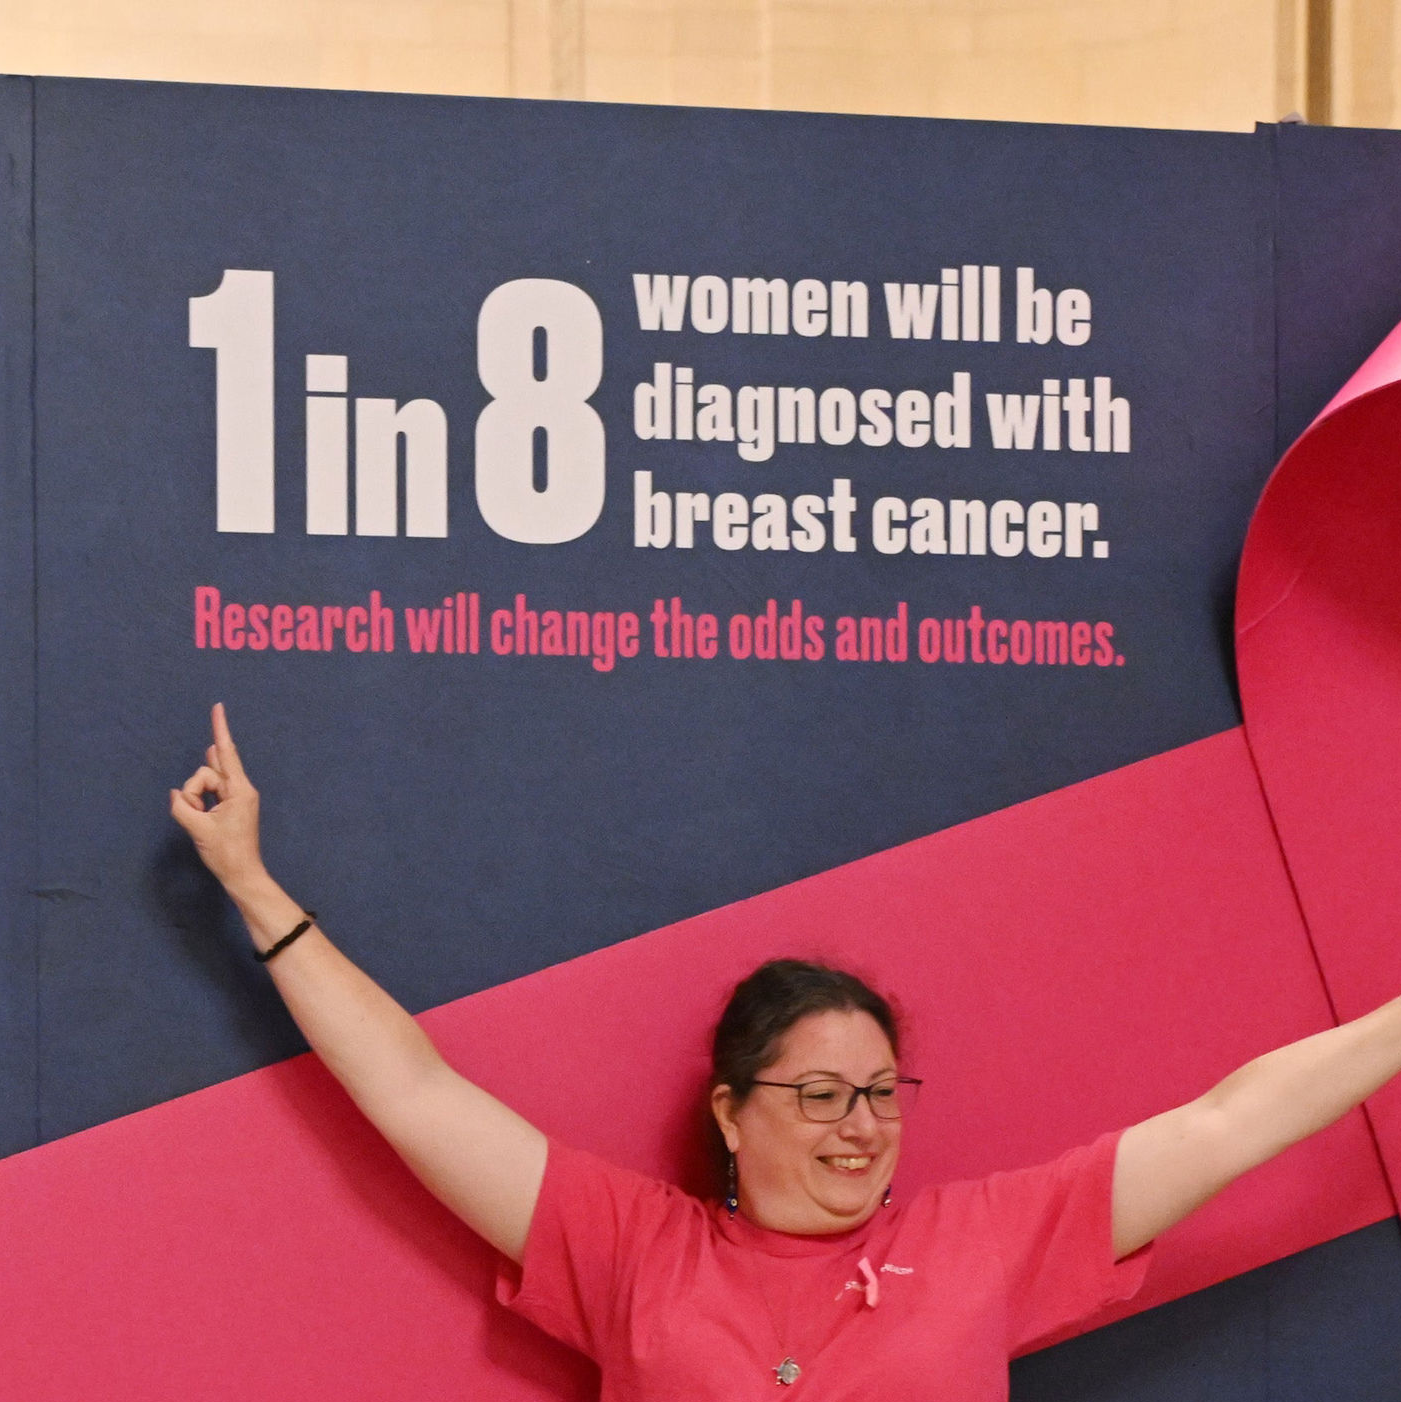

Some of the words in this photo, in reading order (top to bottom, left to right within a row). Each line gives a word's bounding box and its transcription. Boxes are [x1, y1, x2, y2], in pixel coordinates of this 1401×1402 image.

[633, 274, 868, 337] women
[884, 265, 1000, 342] will
[1017, 267, 1091, 346] be
[189, 269, 274, 533] 1
[306, 354, 447, 538] in
[475, 278, 605, 544] 8
[634, 363, 970, 462] diagnosed
[986, 377, 1130, 452] with
[634, 471, 856, 552] breast
[873, 497, 1108, 558] cancer.
[195, 586, 394, 652] Research
[405, 592, 479, 654] will
[491, 594, 639, 672] change
[650, 597, 718, 659] the
[729, 599, 825, 660] odds
[836, 602, 907, 662] and
[919, 606, 1125, 666] outcomes.
